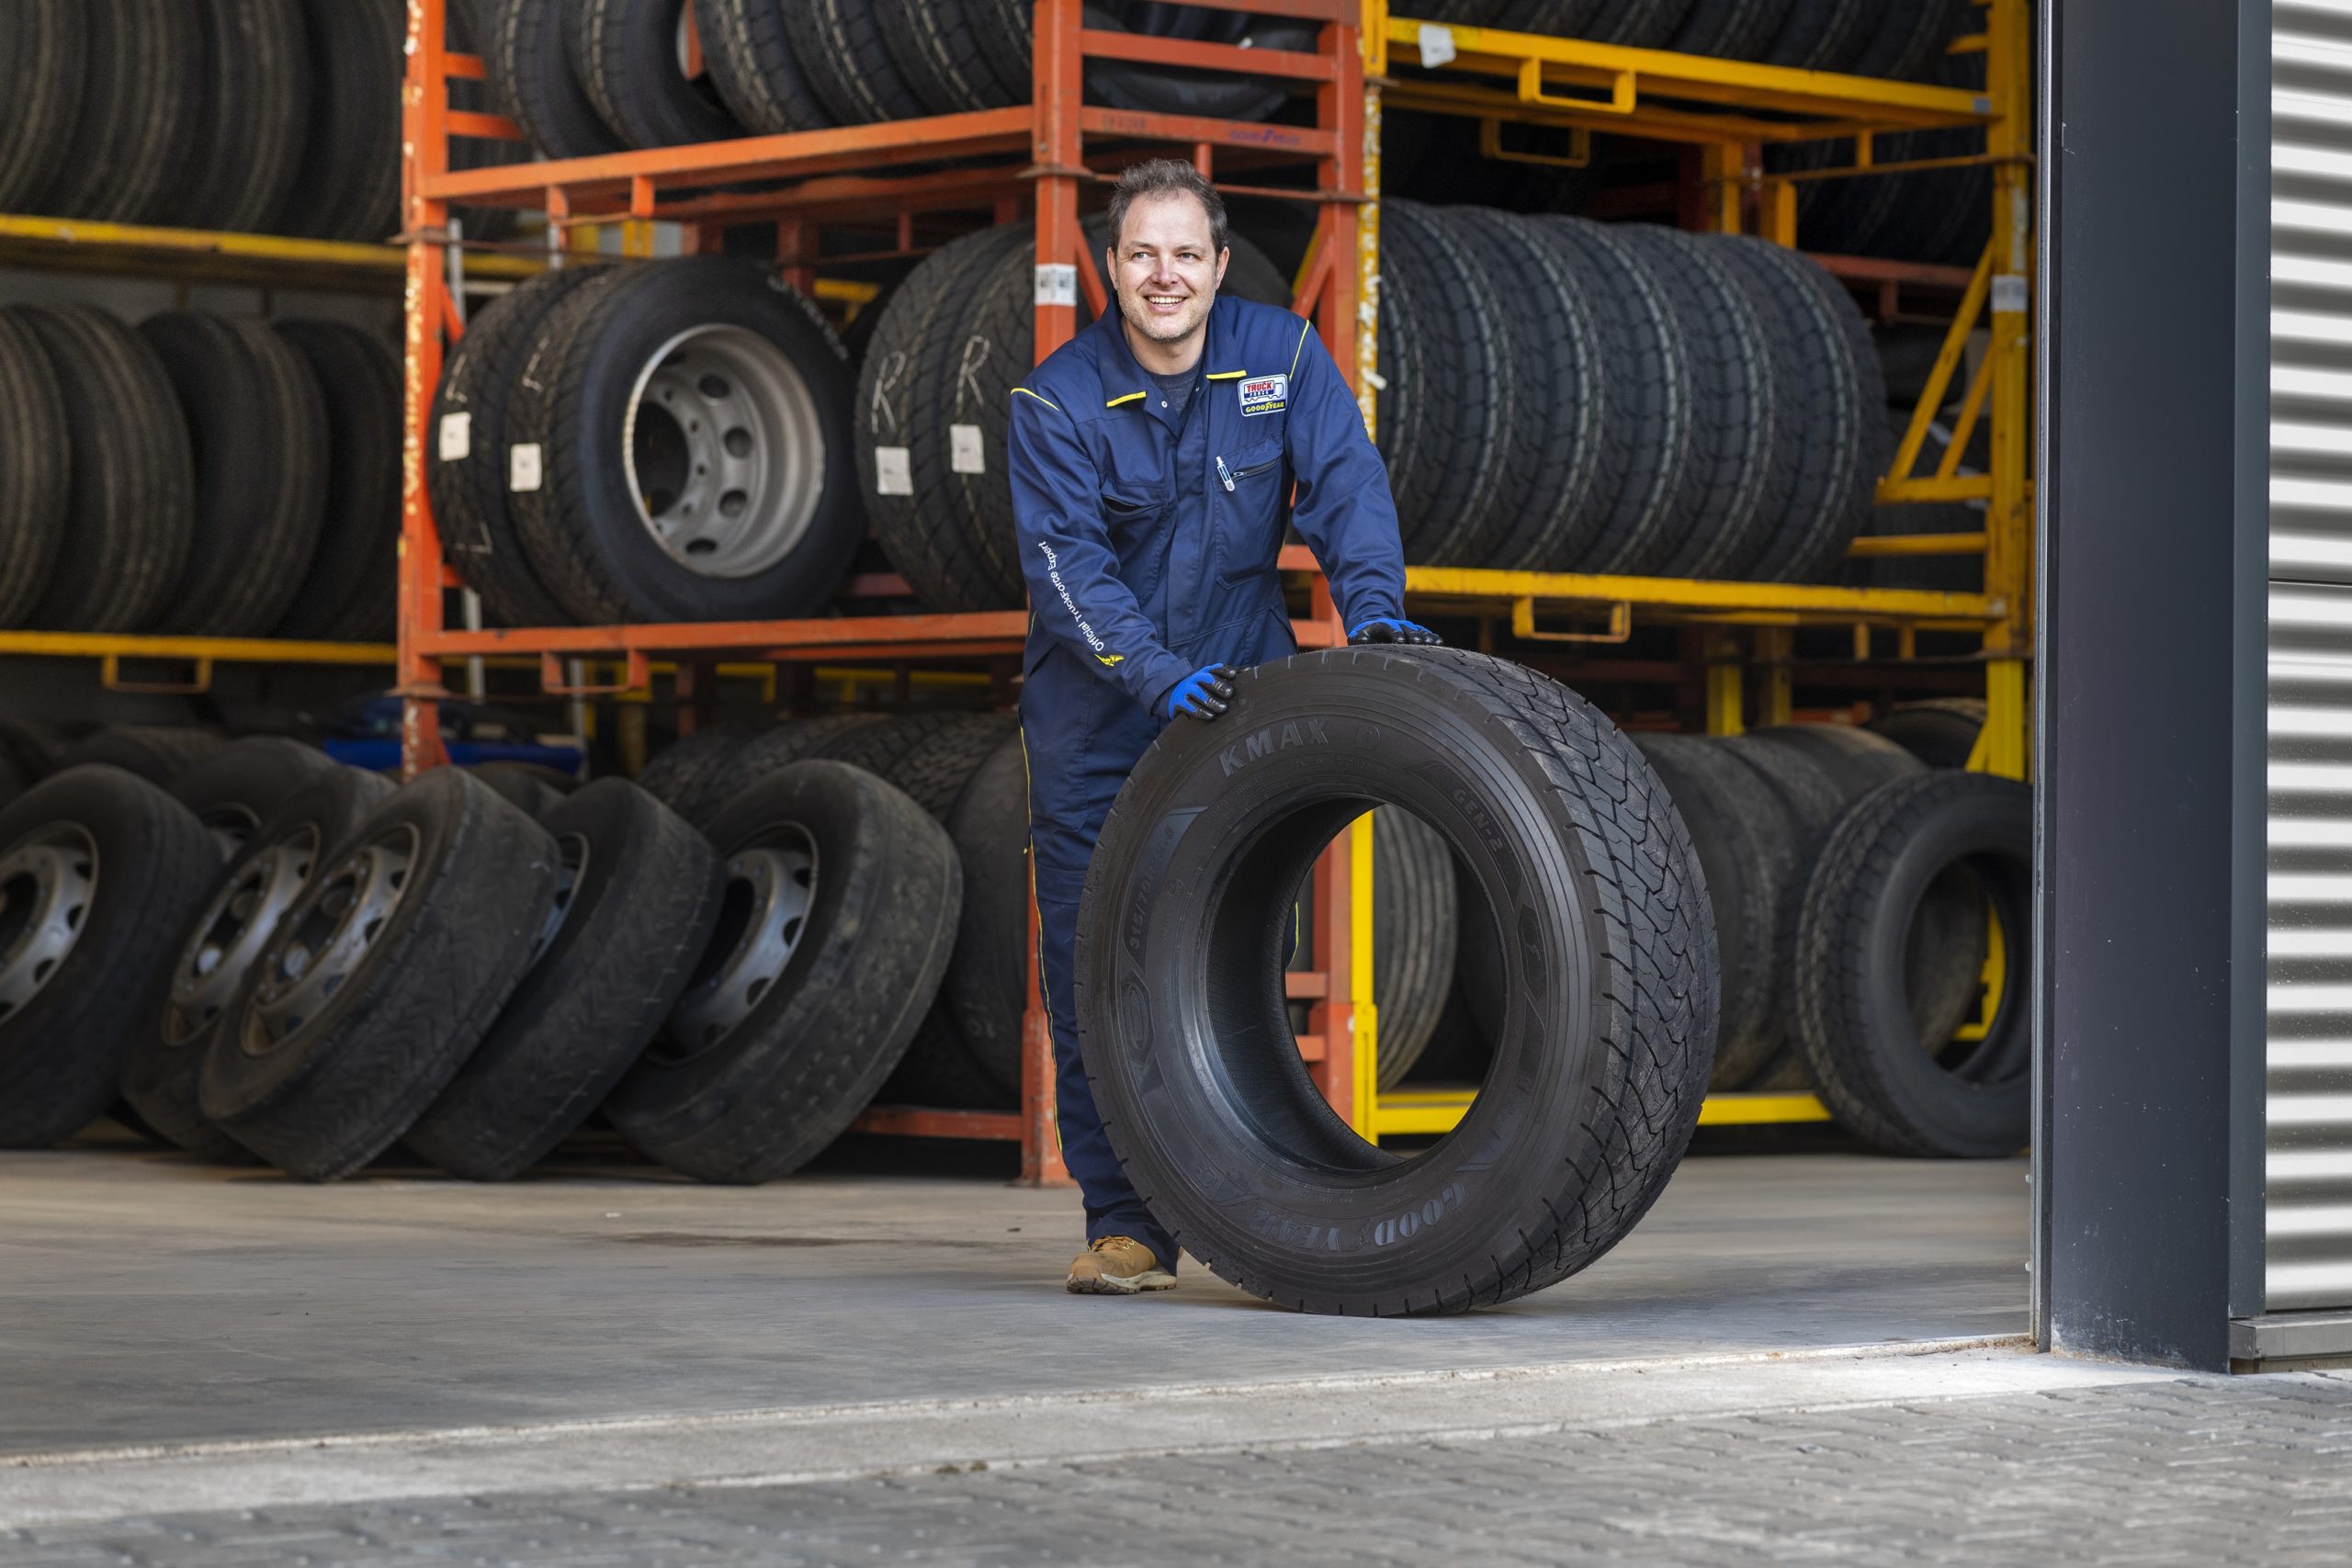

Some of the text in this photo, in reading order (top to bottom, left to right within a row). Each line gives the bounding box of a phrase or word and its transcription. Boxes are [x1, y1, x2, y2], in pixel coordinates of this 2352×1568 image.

[871, 351, 906, 434] R
[956, 335, 990, 418] R
[1246, 401, 1284, 412] GOODYEAR
[1247, 382, 1272, 392] TRUCK
[1038, 541, 1104, 651] Official TruckForce Expert
[1218, 718, 1329, 778] KMAX
[1453, 788, 1503, 852] GEN-2
